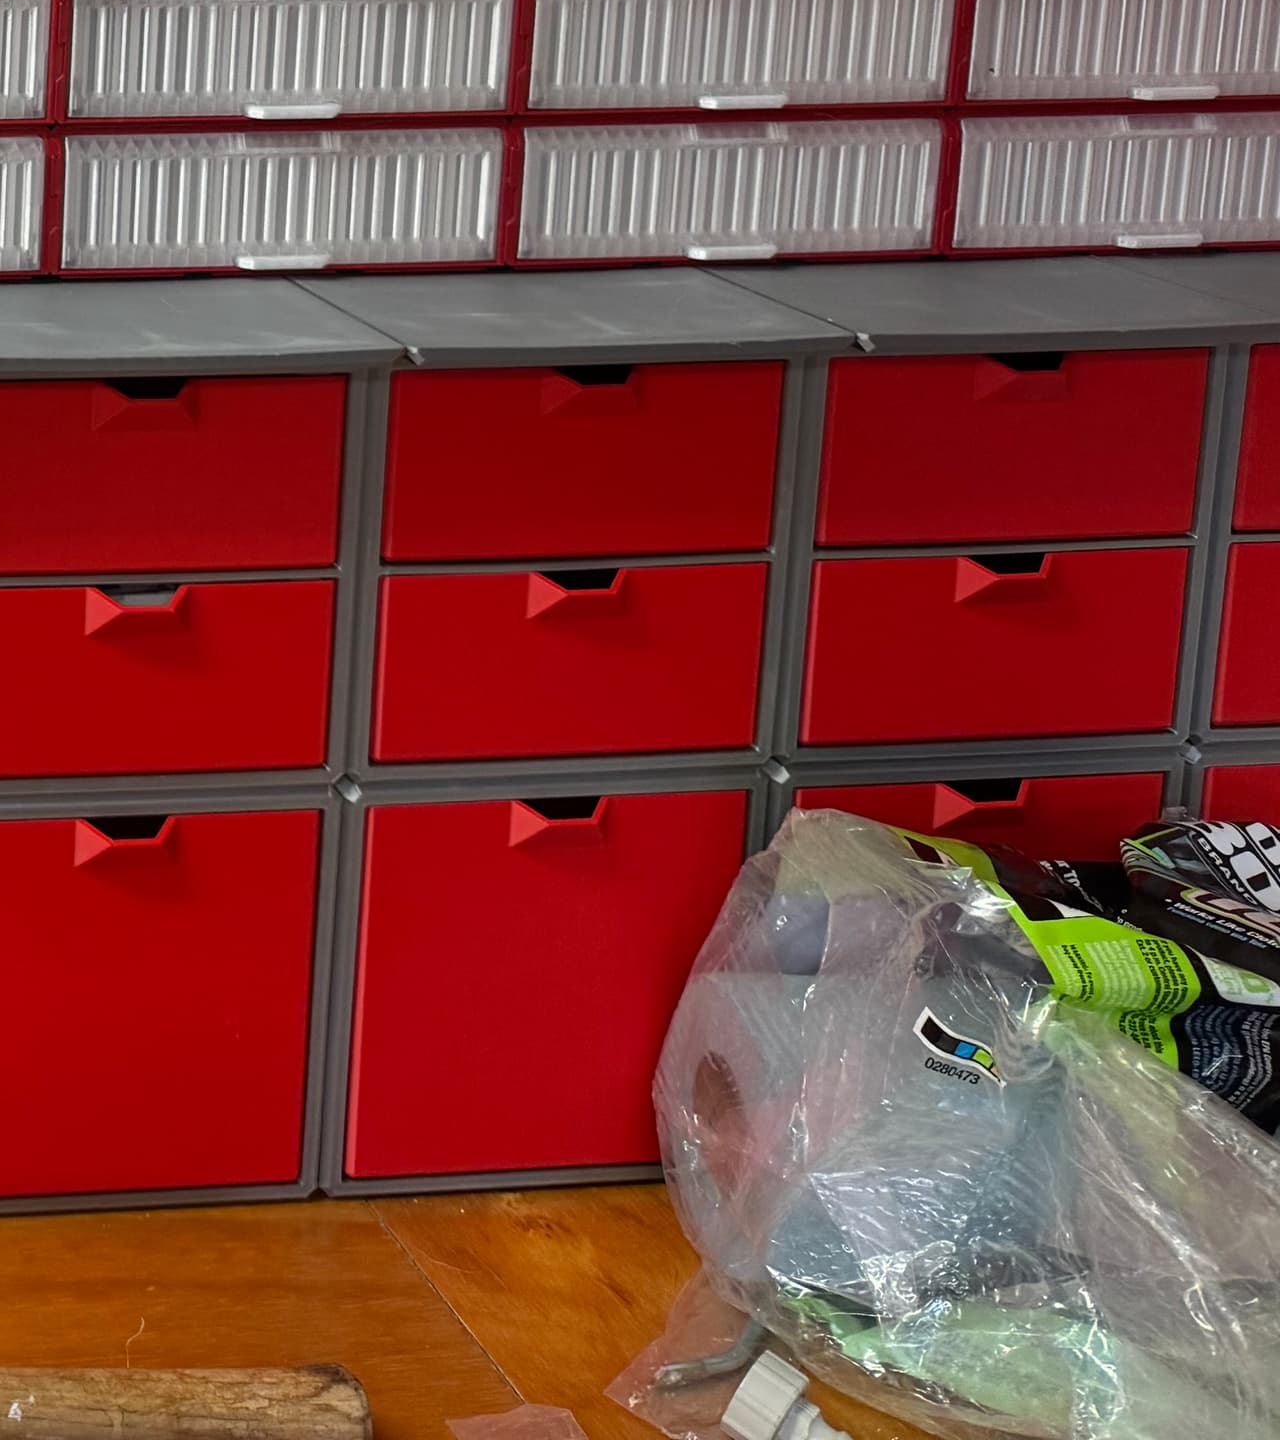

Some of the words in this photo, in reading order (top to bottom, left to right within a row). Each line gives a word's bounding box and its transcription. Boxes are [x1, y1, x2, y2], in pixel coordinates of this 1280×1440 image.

[1197, 837, 1258, 905] BRAND
[1173, 902, 1216, 921] Works
[1216, 919, 1246, 933] Like
[924, 1057, 981, 1084] 0280473
